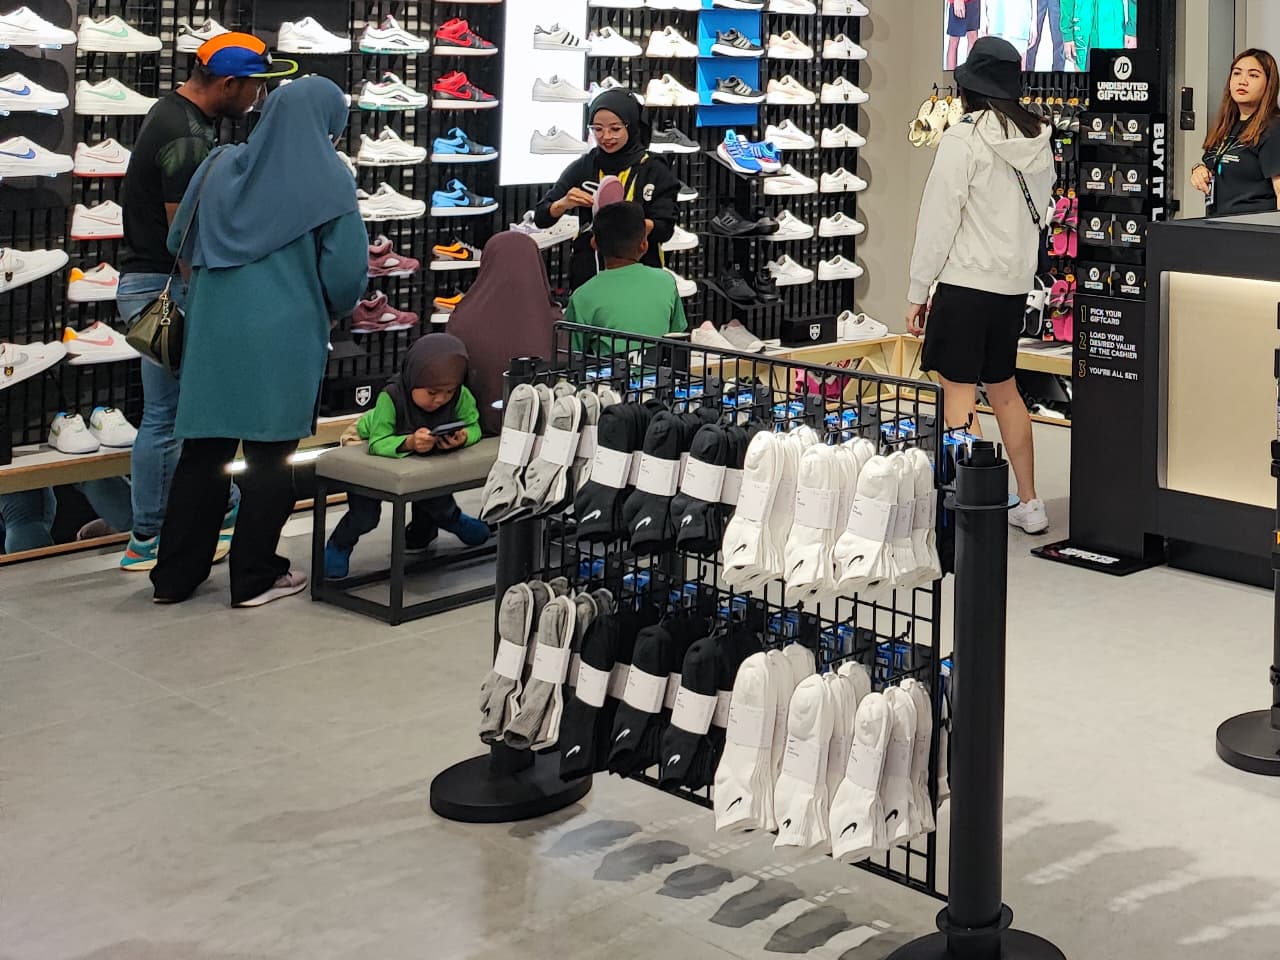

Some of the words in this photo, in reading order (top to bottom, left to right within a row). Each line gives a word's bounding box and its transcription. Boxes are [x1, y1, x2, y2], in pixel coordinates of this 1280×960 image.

[1096, 81, 1149, 91] UNDISPUTED
[1096, 90, 1149, 102] GIFTCARD
[1152, 123, 1165, 172] BUY
[1152, 176, 1165, 199] IT
[1080, 304, 1087, 323] 1
[1089, 307, 1105, 316] PICK
[1104, 309, 1122, 318] YOUR
[1089, 315, 1120, 326] GIFTCARD
[1078, 331, 1087, 350] 2
[1089, 331, 1107, 340] LOAD
[1107, 333, 1125, 342] YOUR
[1089, 338, 1115, 349] DESIRED
[1115, 342, 1137, 352] VALUE
[1097, 347, 1111, 356] THE
[1110, 349, 1138, 360] CASHIER
[1078, 359, 1087, 378] 3
[1111, 369, 1124, 378] ALL
